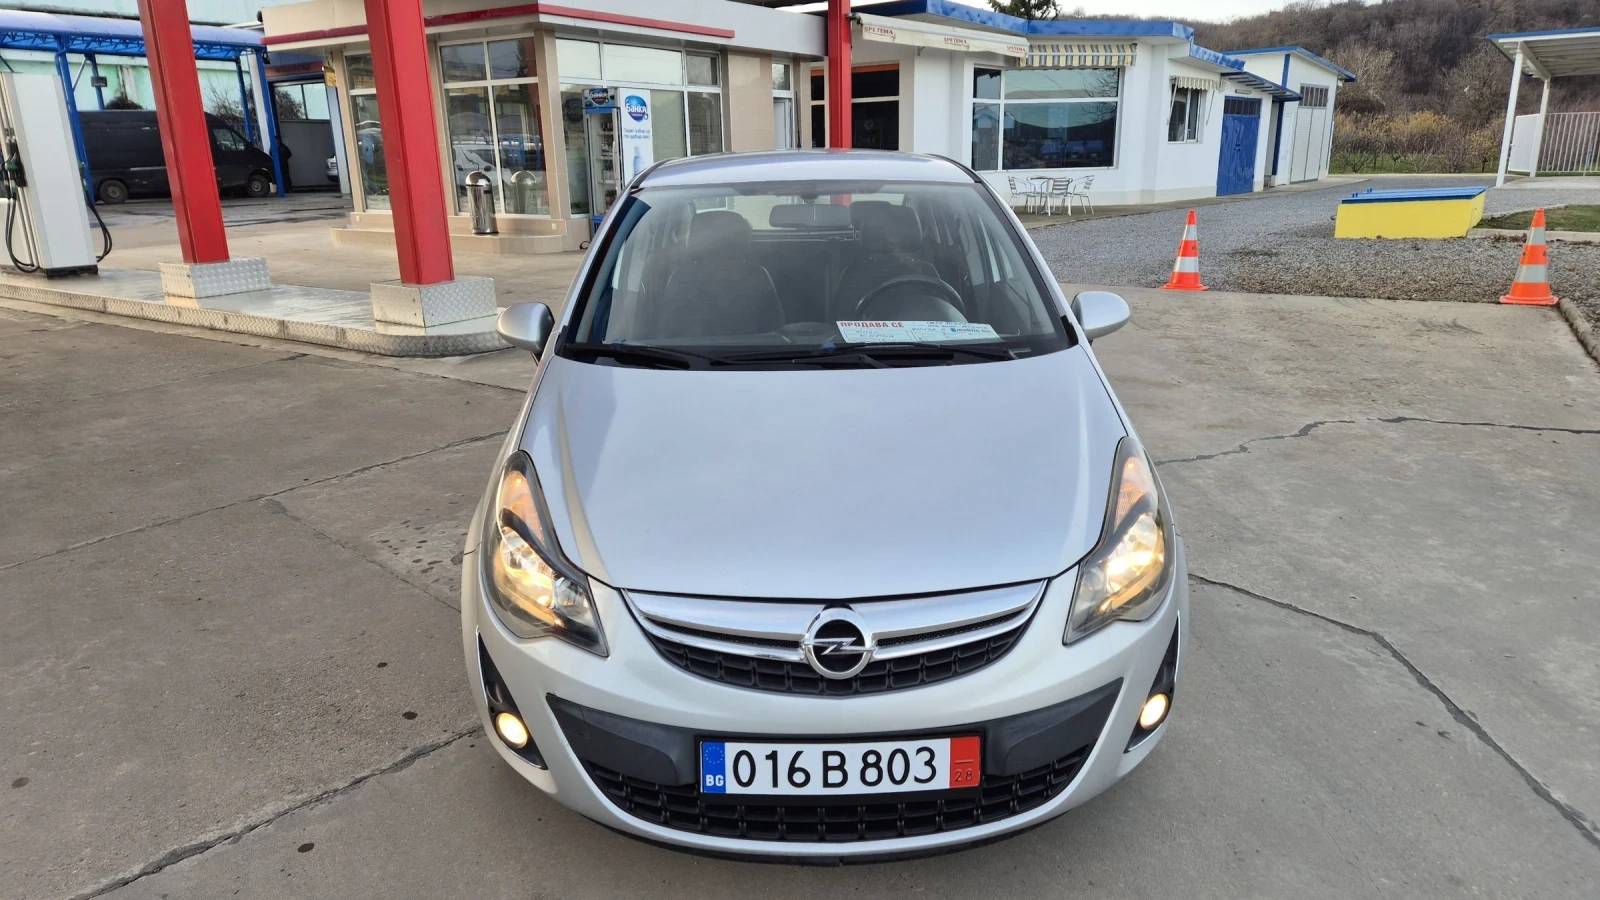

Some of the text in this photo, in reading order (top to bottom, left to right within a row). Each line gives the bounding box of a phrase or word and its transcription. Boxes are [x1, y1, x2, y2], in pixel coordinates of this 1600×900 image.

[864, 26, 893, 35] SPETEMA
[705, 775, 725, 787] BG
[732, 749, 811, 788] 016
[860, 746, 937, 786] 803
[954, 769, 973, 782] 28
